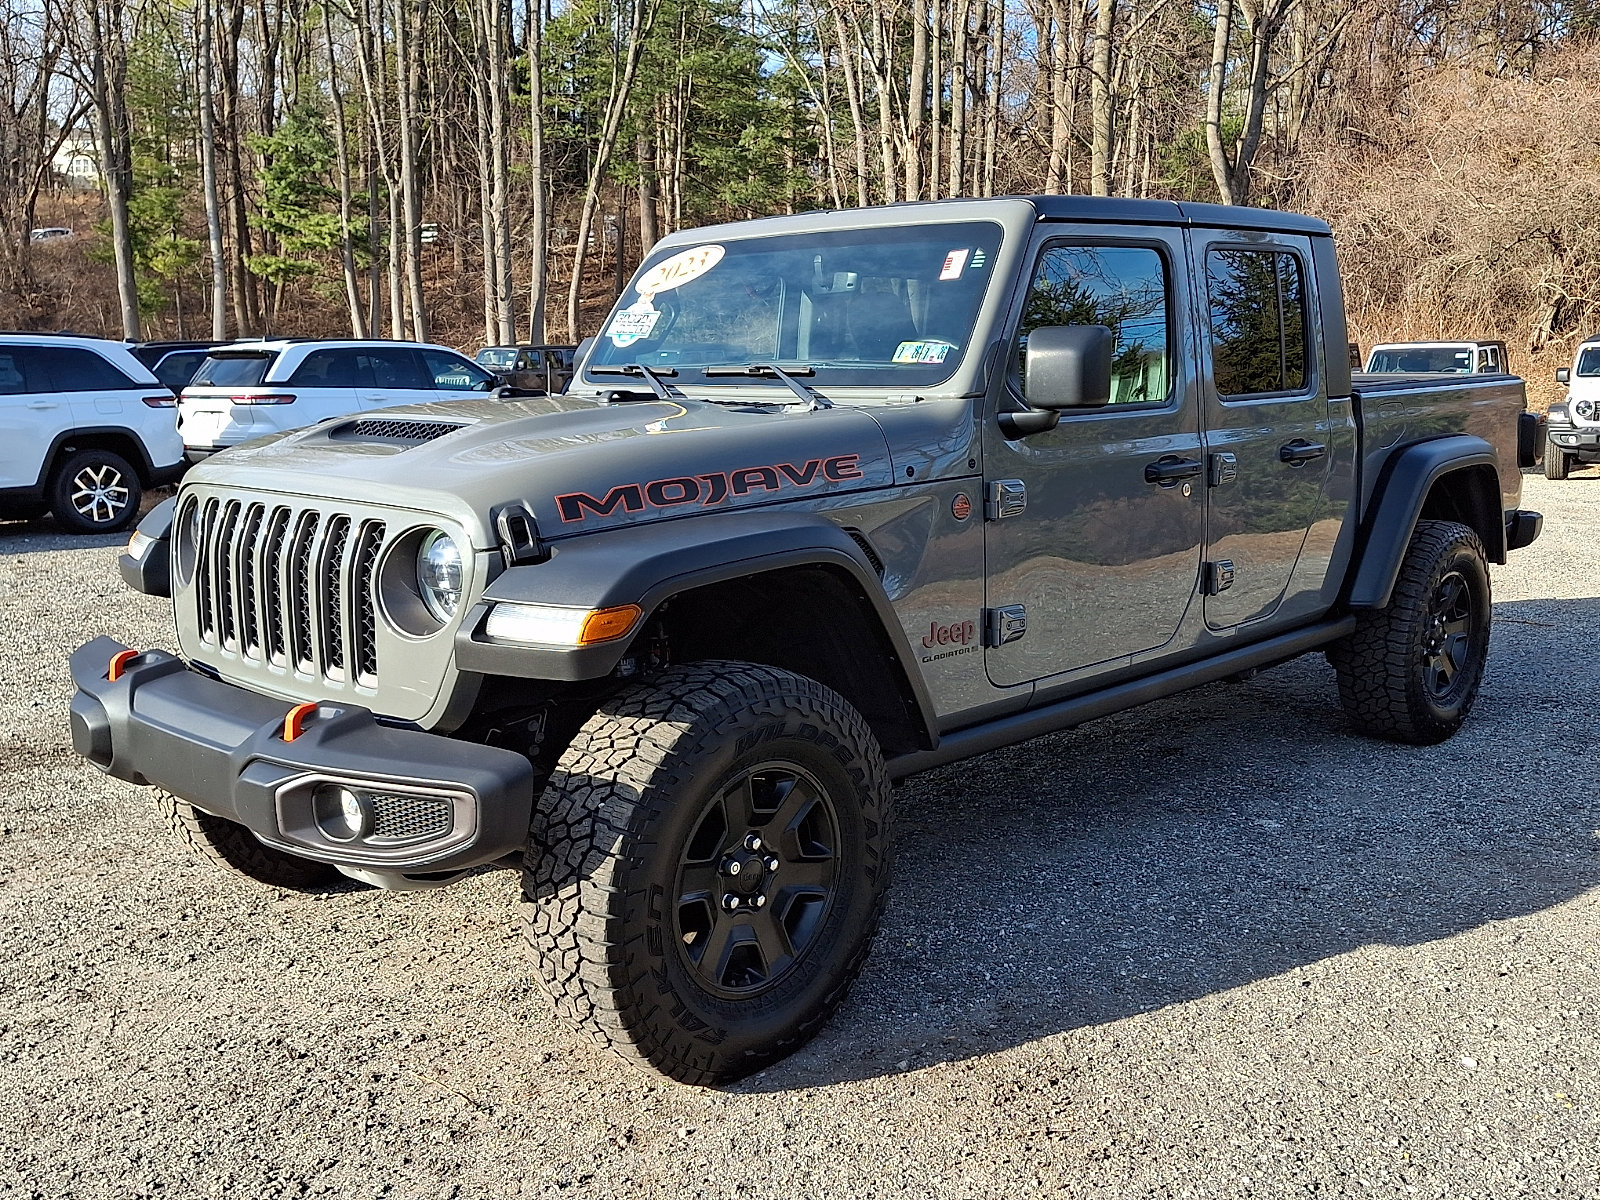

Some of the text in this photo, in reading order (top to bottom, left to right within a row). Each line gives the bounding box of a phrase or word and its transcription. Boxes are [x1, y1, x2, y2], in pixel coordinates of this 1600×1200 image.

[649, 251, 715, 288] 2023
[554, 453, 863, 523] MOJAVE
[922, 620, 975, 649] Jeep
[922, 647, 970, 663] GLADIATOR
[734, 721, 876, 808] WILDPEAK
[646, 882, 729, 1045] FALKEN
